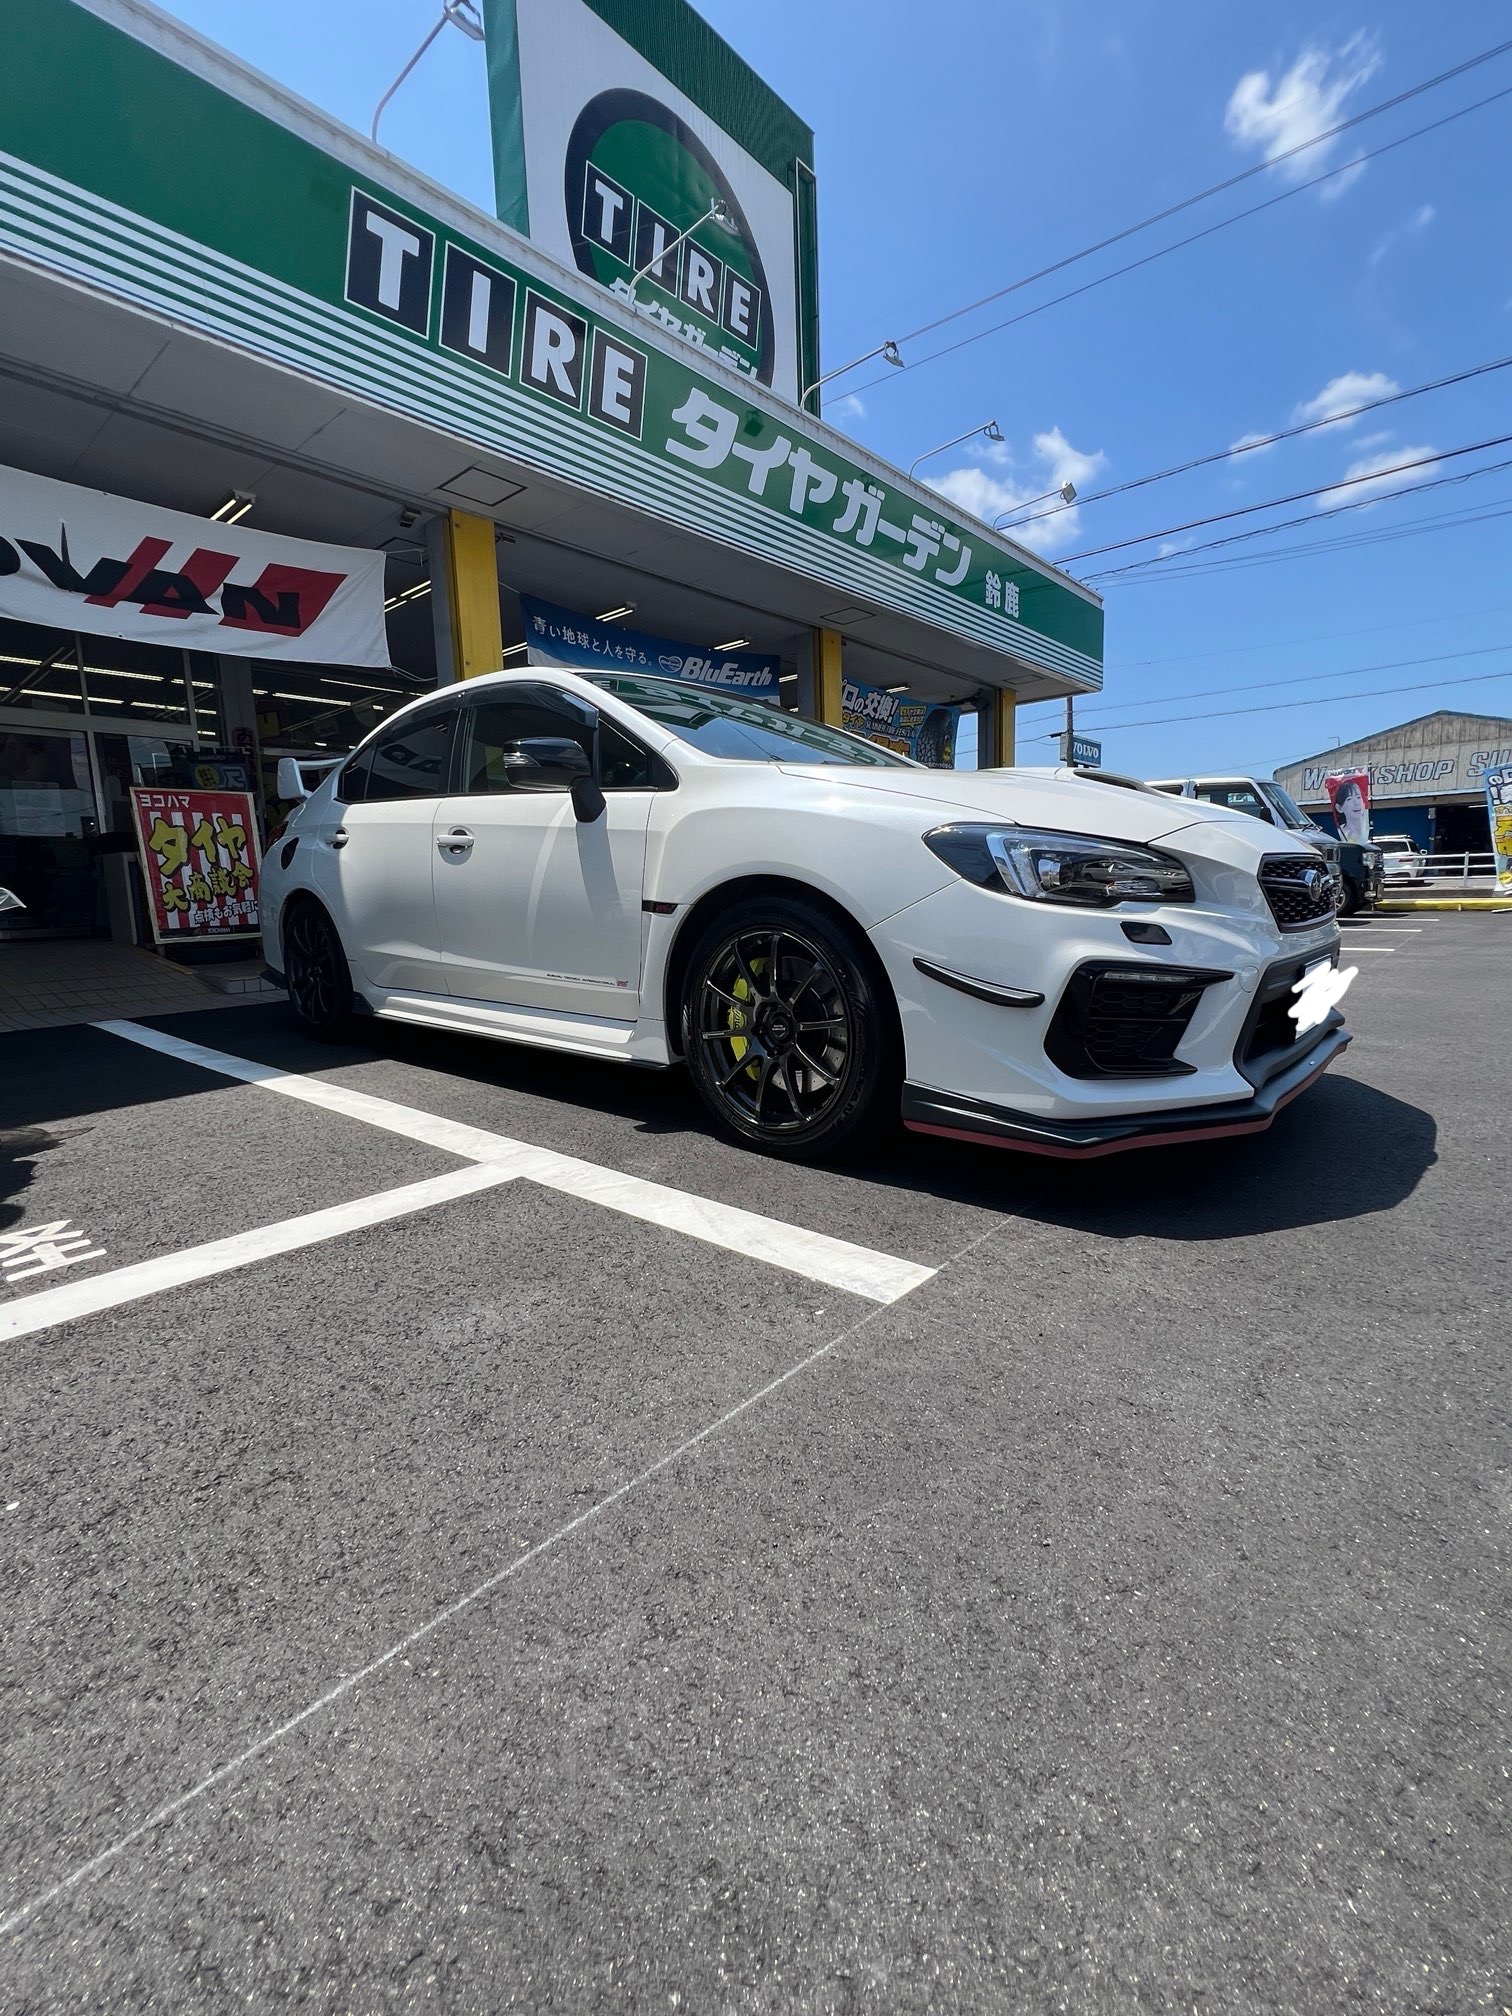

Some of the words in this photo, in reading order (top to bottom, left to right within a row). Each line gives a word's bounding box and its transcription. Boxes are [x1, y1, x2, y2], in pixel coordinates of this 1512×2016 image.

[592, 173, 752, 337] TIRE
[364, 206, 637, 428] TIRE
[665, 387, 972, 588] タイヤガーデン
[984, 569, 1021, 620] 鈴鹿
[0, 534, 340, 637] VAN
[532, 615, 653, 667] 青い地球と人を守る。
[681, 656, 773, 686] BluEarth
[841, 679, 900, 723] ロの交換!
[1073, 741, 1099, 759] VOLVO
[139, 794, 191, 808] ヨコハマ
[148, 816, 248, 877] タイヤ
